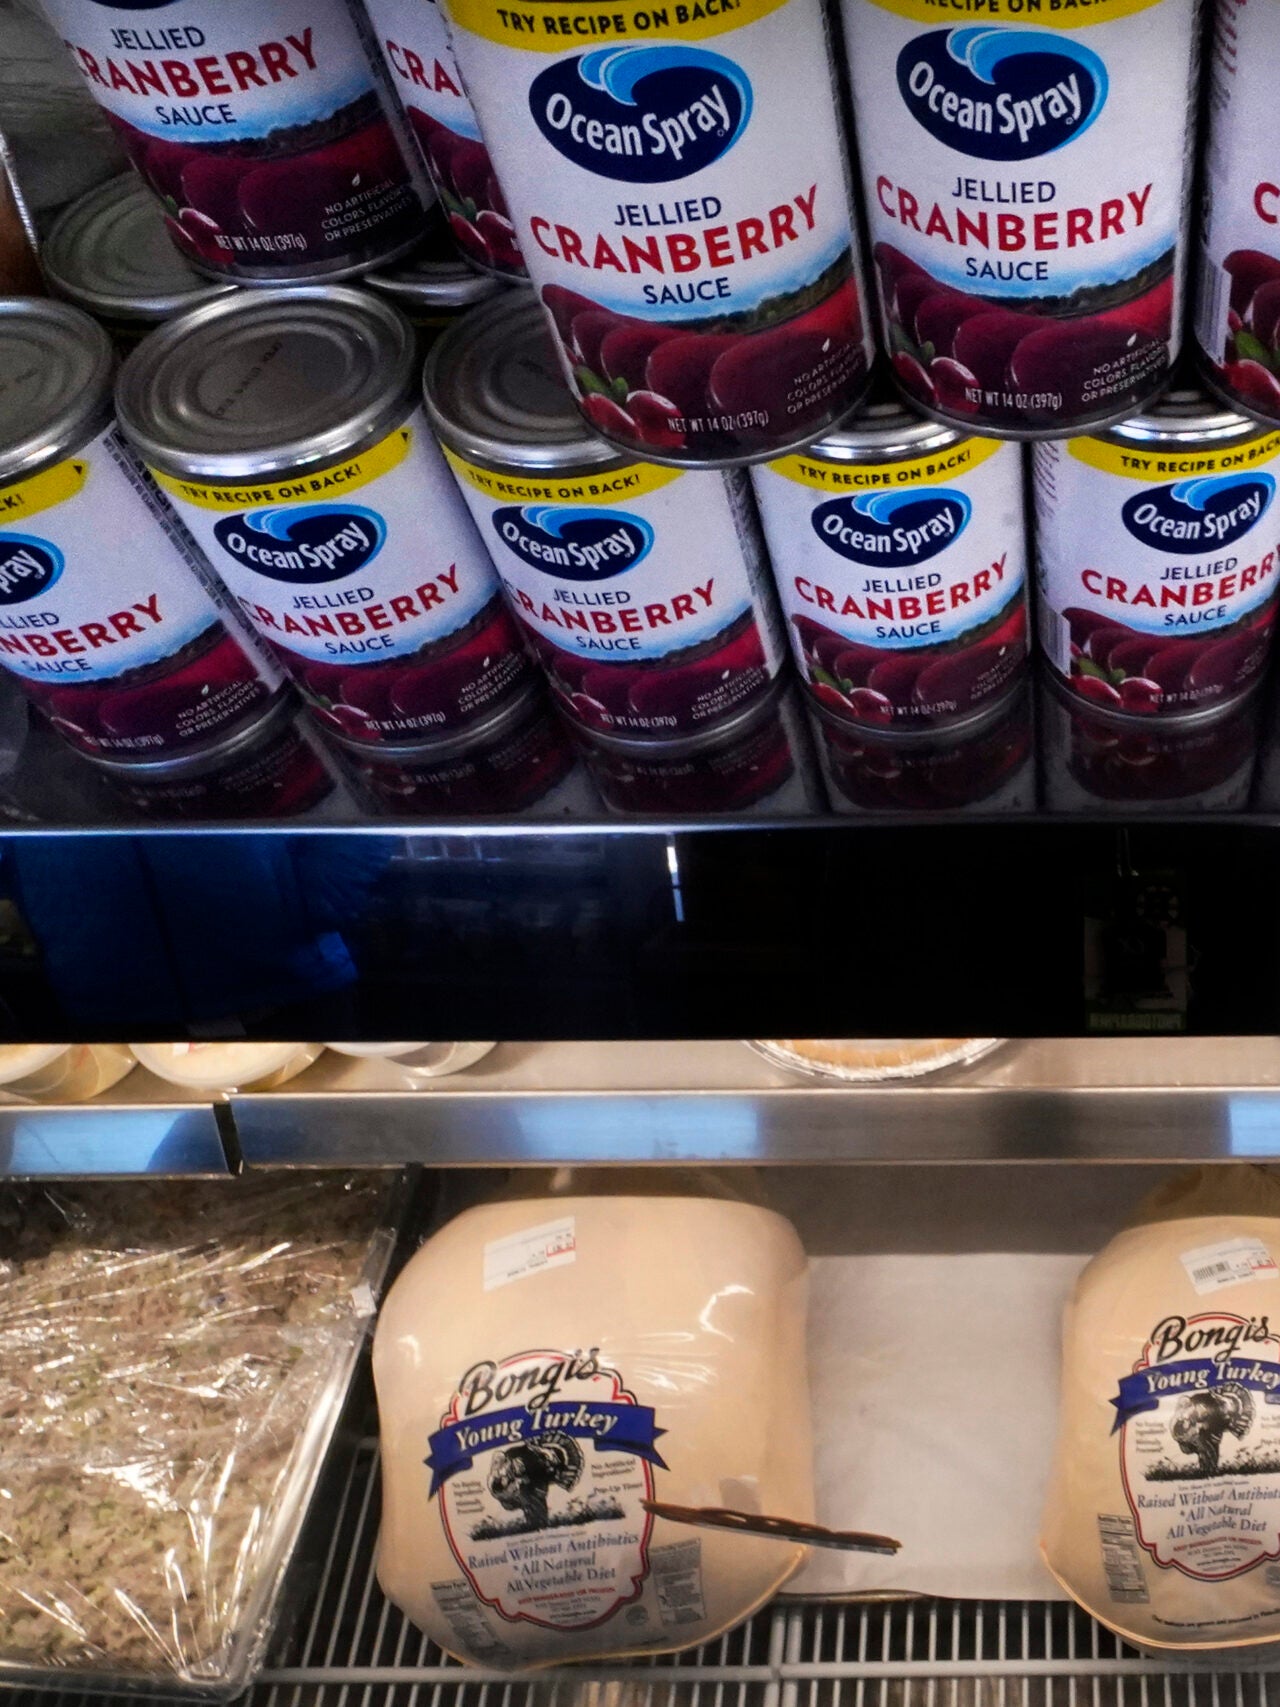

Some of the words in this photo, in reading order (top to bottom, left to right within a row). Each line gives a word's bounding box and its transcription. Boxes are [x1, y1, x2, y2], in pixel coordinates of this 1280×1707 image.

[497, 9, 535, 33] TRY
[544, 13, 627, 36] RECIPE
[634, 9, 669, 30] ON
[110, 26, 206, 51] JELLIED
[908, 61, 993, 134] Ocean
[999, 73, 1083, 143] Spray
[155, 103, 237, 126] SAUCE
[545, 92, 643, 156] Ocean
[650, 84, 732, 161] Spray
[952, 177, 1056, 203] JELLIED
[614, 196, 722, 227] JELLIED
[876, 175, 1154, 252] CRANBERRY
[529, 183, 819, 275] CRANBERRY
[966, 257, 1048, 281] SAUCE
[642, 277, 732, 305] SAUCE
[1093, 363, 1110, 375] NO
[985, 391, 999, 406] WT
[1002, 393, 1013, 407] 14
[1081, 391, 1098, 402] OR
[667, 417, 687, 432] NET
[689, 418, 705, 432] WT
[707, 417, 720, 431] 14
[798, 464, 826, 482] TRY
[832, 473, 891, 485] RECIPE
[897, 467, 922, 482] ON
[926, 450, 971, 476] BACK!
[1120, 455, 1151, 471] TRY
[1156, 460, 1216, 473] RECIPE
[1221, 453, 1244, 469] ON
[181, 484, 208, 501] TRY
[214, 486, 273, 503] RECIPE
[278, 482, 306, 498] ON
[310, 463, 363, 492] BACK!
[468, 470, 493, 489] TRY
[497, 480, 553, 499] RECIPE
[558, 486, 584, 499] ON
[588, 474, 641, 496] BACK!
[1133, 502, 1200, 540] Ocean
[1203, 490, 1262, 540] Spray
[822, 513, 891, 553] Ocean
[895, 506, 956, 555] Spray
[227, 532, 304, 569] Ocean
[308, 521, 368, 570] Spray
[502, 521, 570, 567] Ocean
[574, 528, 635, 571] Spray
[0, 549, 45, 594] pray
[1160, 557, 1238, 581] JELLIED
[794, 552, 1008, 622] CRANBERRY
[862, 573, 942, 593] JELLIED
[292, 586, 375, 610] JELLIED
[552, 588, 631, 606] JELLIED
[1164, 605, 1228, 627] SAUCE
[876, 620, 942, 639] SAUCE
[324, 635, 395, 655] SAUCE
[576, 635, 641, 651] SAUCE
[21, 659, 93, 674] SAUCE
[1147, 1367, 1209, 1394] Young
[455, 1418, 525, 1451] Young
[530, 1404, 619, 1436] Turkey
[1137, 1494, 1176, 1508] Raised
[1179, 1489, 1225, 1506] Without
[1207, 1503, 1252, 1517] Natural
[1167, 1526, 1184, 1540] All
[1187, 1516, 1237, 1536] Vegetable
[1240, 1519, 1267, 1532] Diet
[543, 1553, 596, 1572] Natural
